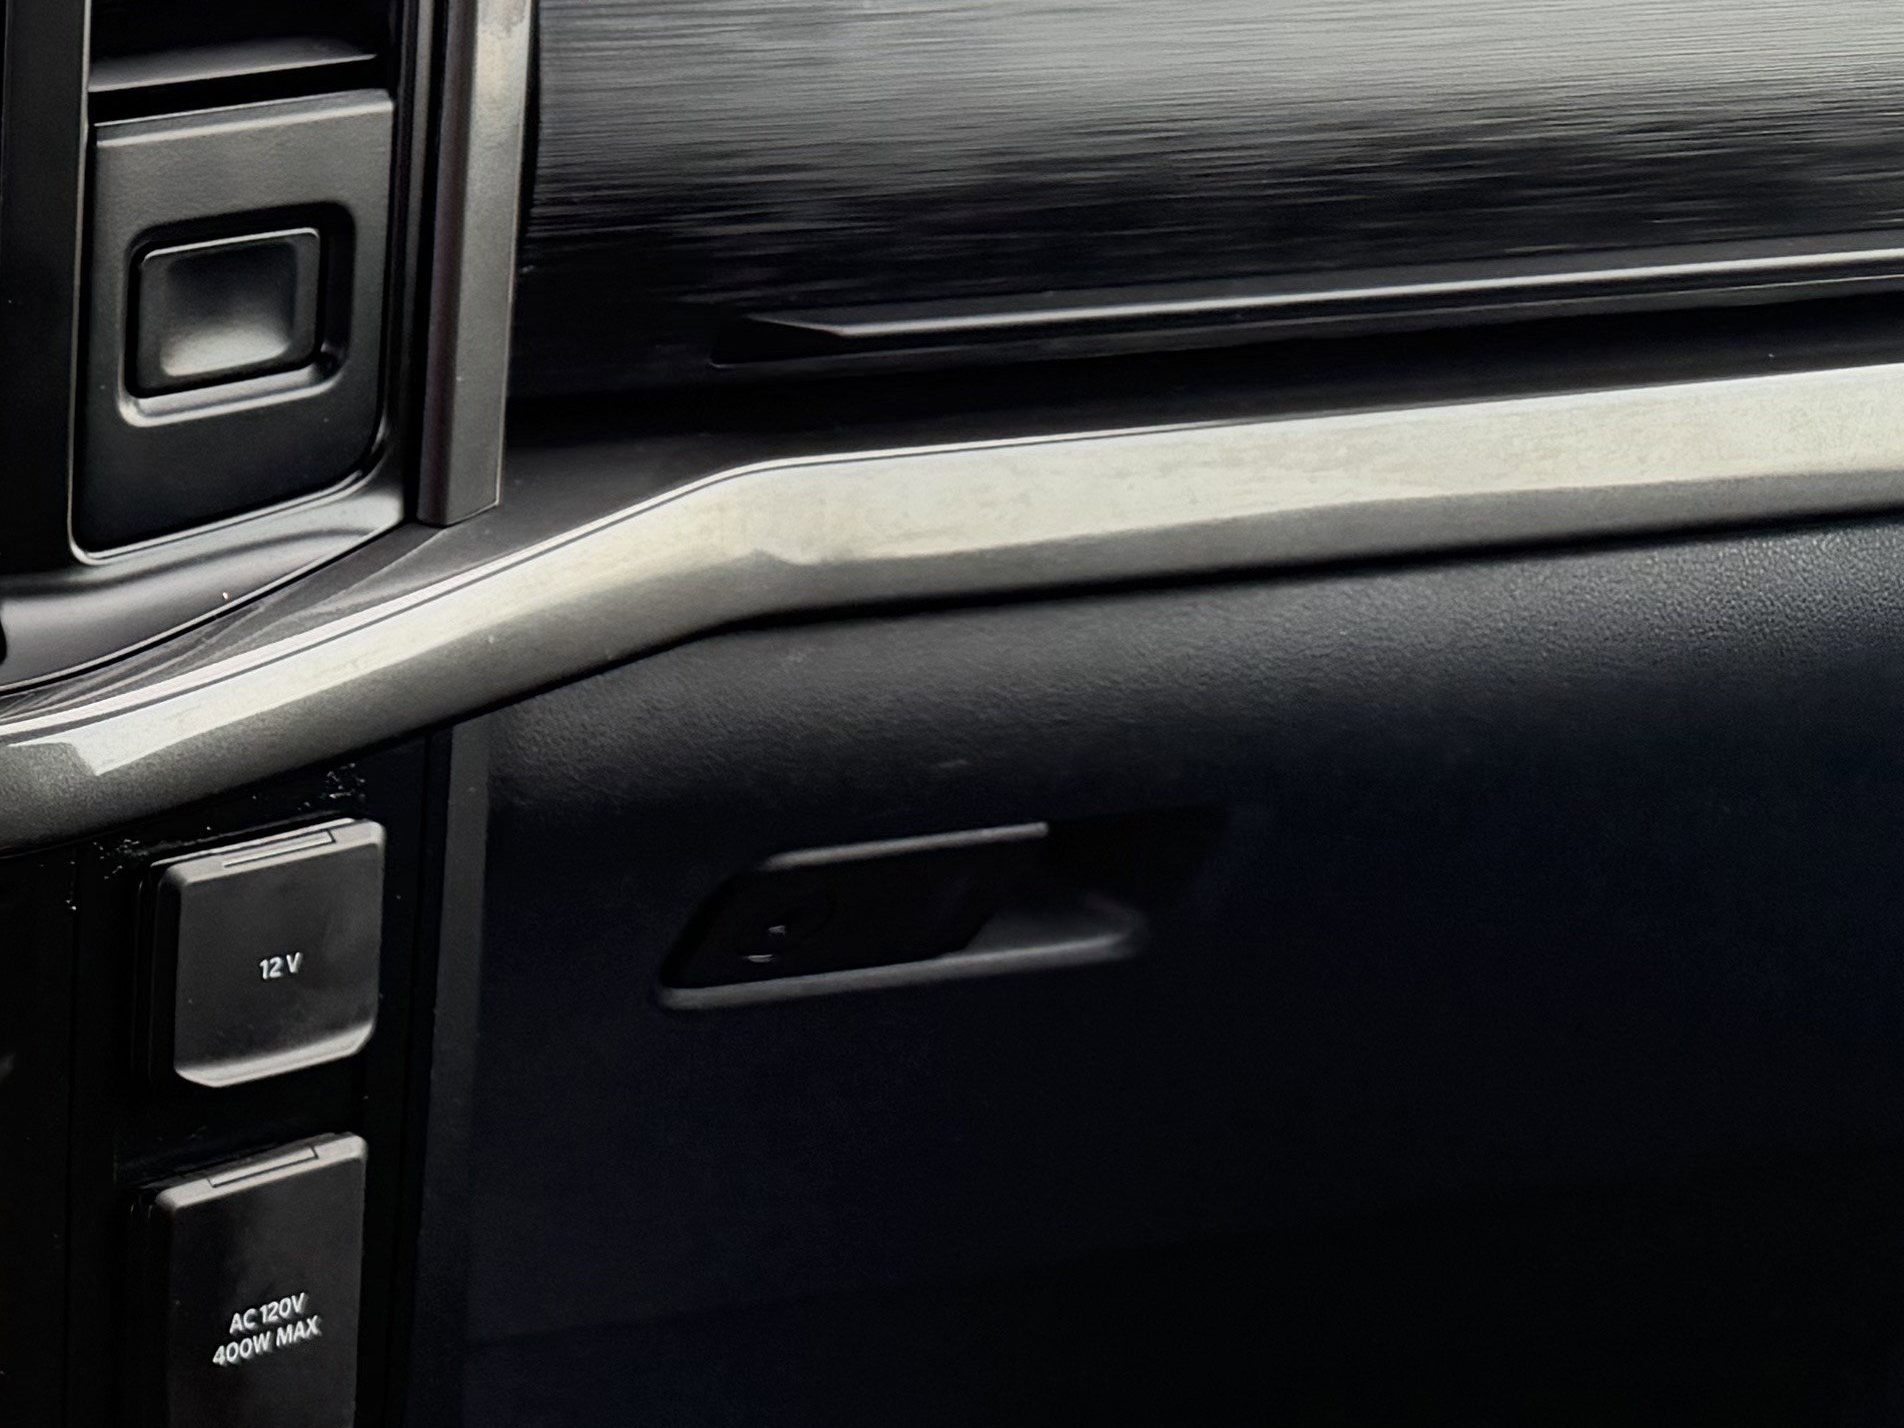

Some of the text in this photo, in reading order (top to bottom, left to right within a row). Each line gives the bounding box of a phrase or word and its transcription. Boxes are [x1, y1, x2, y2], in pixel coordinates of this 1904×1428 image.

[259, 951, 304, 982] 12 V
[229, 1292, 308, 1336] AC 120V
[212, 1313, 323, 1368] 400W MAX
